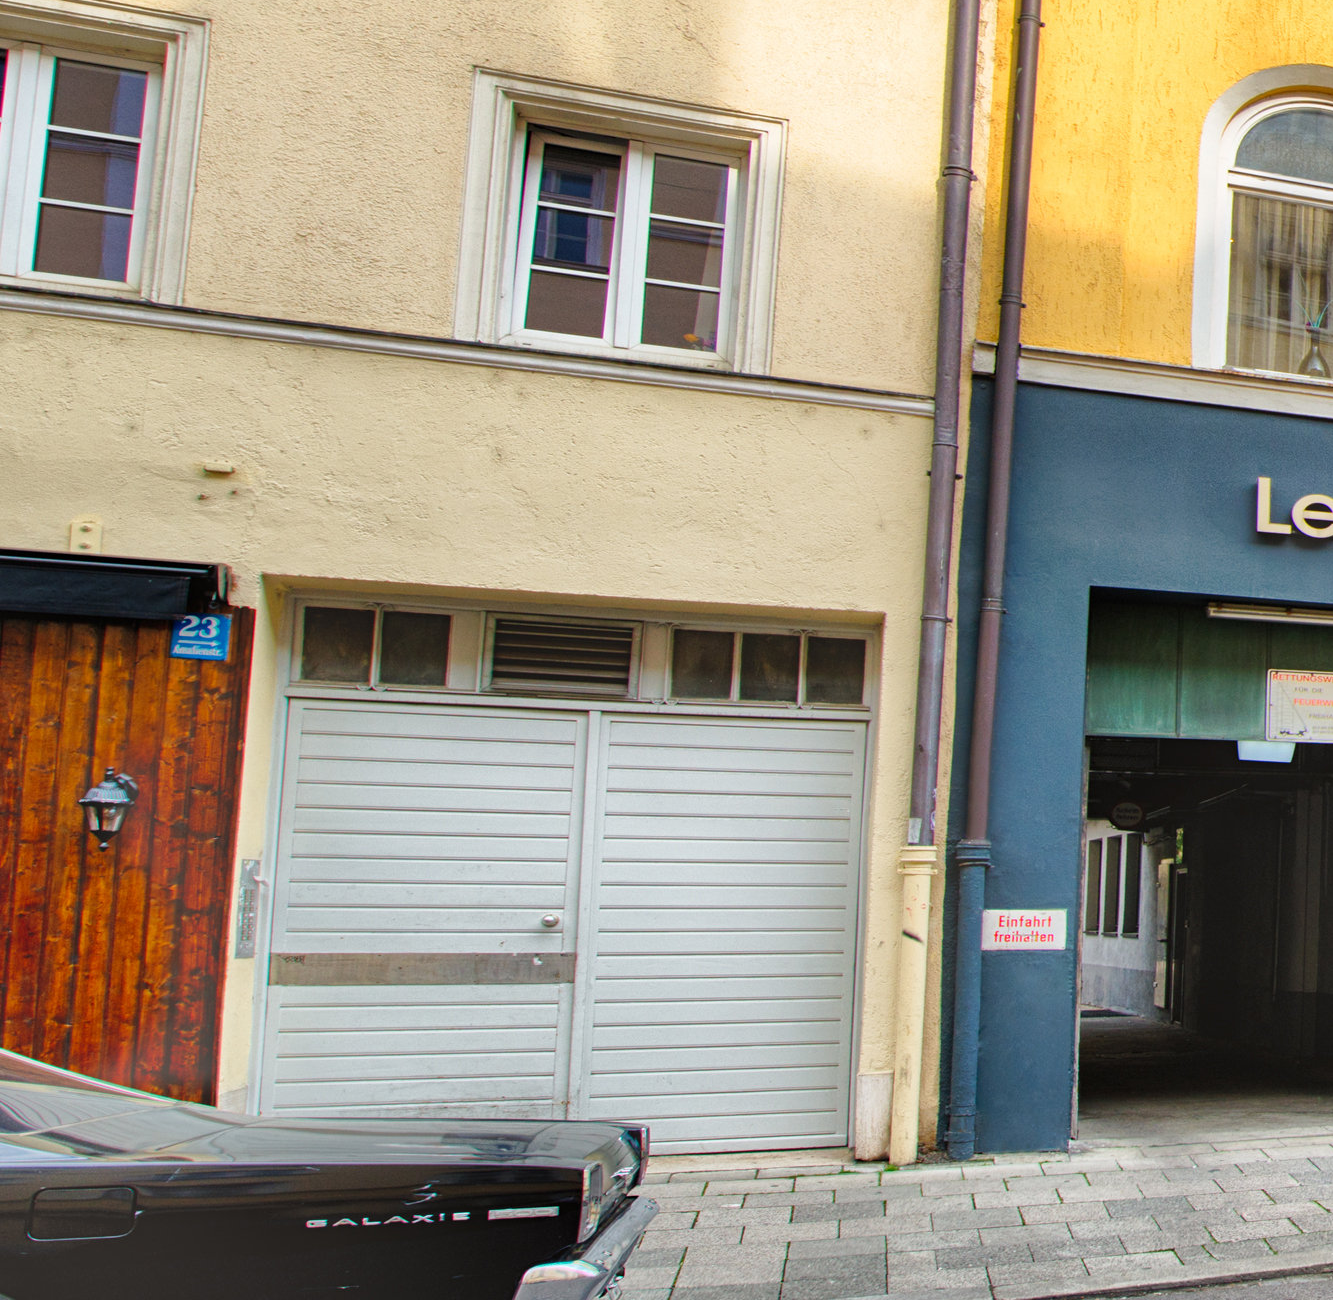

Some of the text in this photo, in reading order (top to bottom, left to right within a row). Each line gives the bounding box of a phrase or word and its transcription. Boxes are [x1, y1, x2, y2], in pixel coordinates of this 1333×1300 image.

[179, 615, 220, 638] 23
[998, 915, 1051, 927] Einfahrt
[994, 931, 1054, 942] freihalten
[306, 1212, 470, 1228] GALAXIE
